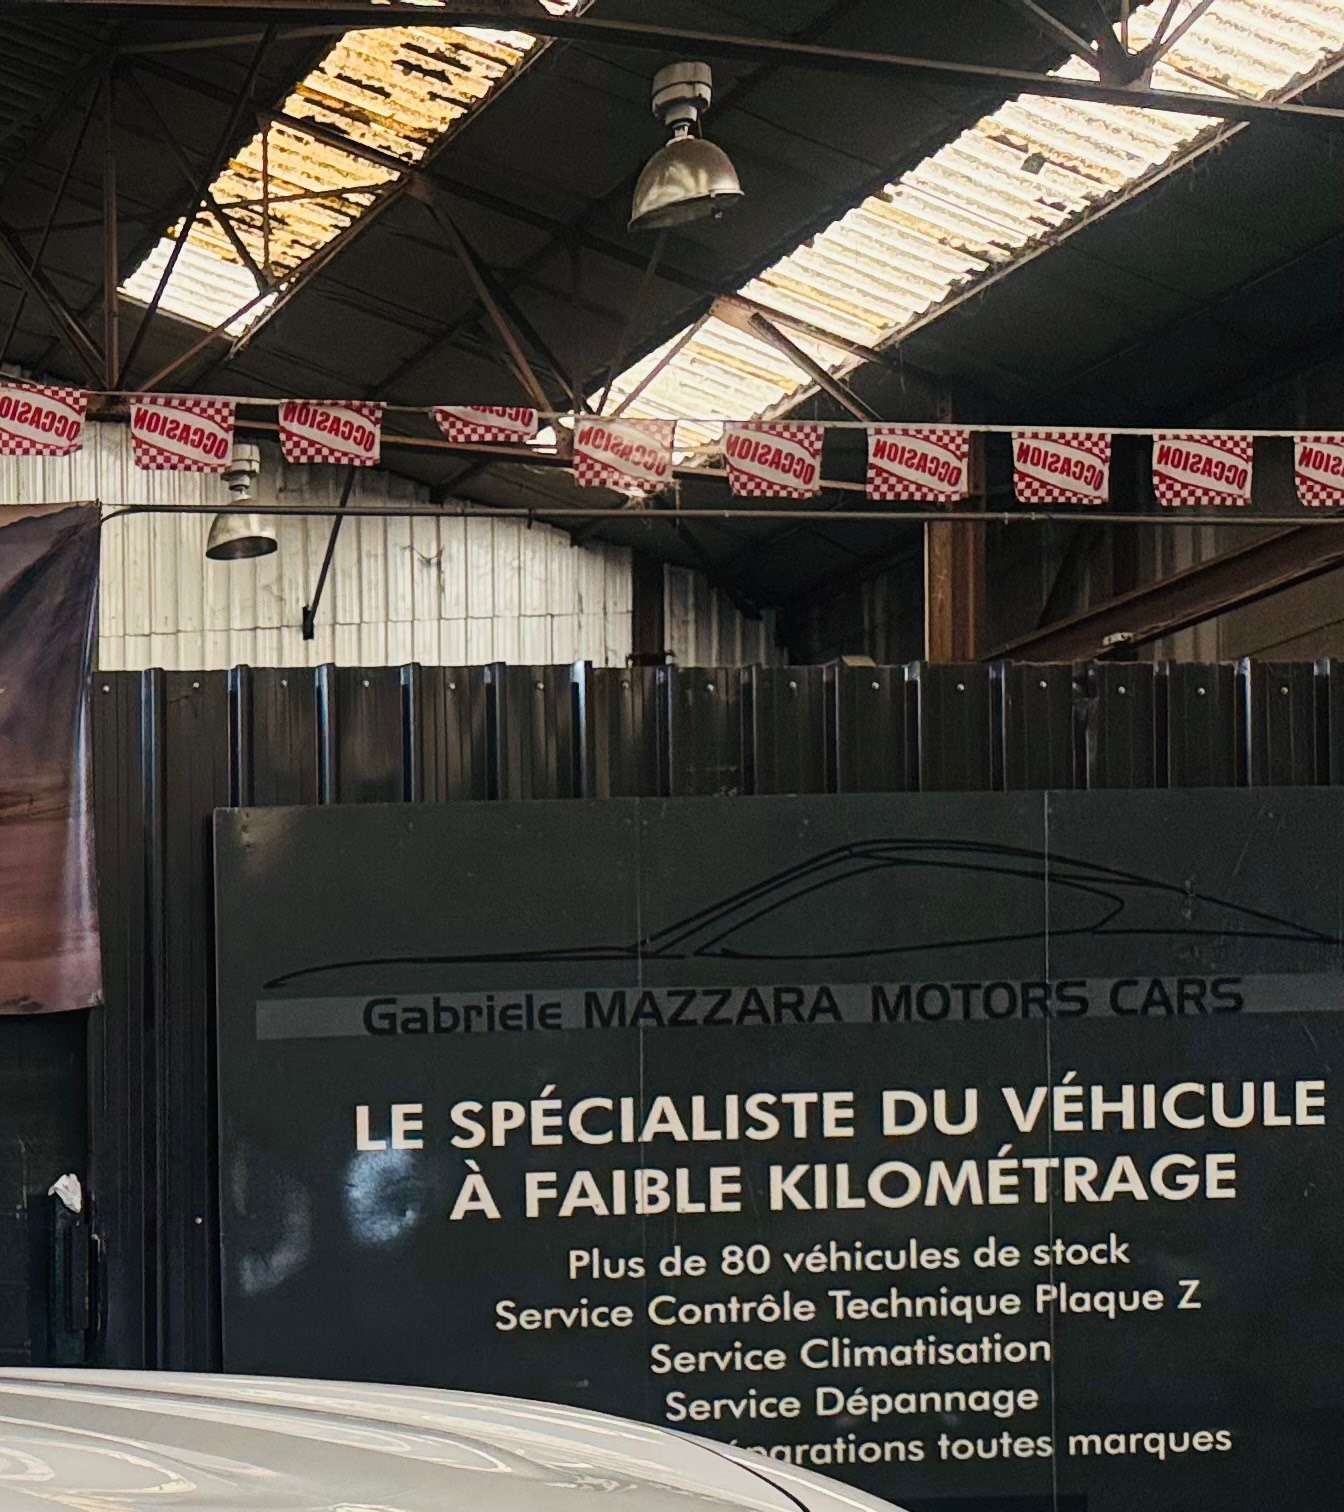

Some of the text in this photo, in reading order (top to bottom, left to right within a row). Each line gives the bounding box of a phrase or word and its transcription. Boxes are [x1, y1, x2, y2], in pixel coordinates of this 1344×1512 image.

[362, 975, 1245, 1037] Gabriele MAZZARA MOTORS CARS
[356, 1070, 1327, 1151] LE SPÉCIALISTE DU VÉHICULE
[448, 1143, 1237, 1221] À FAIBLE KILOMÉTRAGE
[569, 1232, 1132, 1280] Plus de 80 véhicules de stock
[495, 1279, 1202, 1331] Service Contrôle Technique Plaque Z
[650, 1332, 1051, 1374] Service Climatisation
[665, 1385, 1040, 1422] Service Dépannage
[730, 1429, 1233, 1465] arations toutes marques
